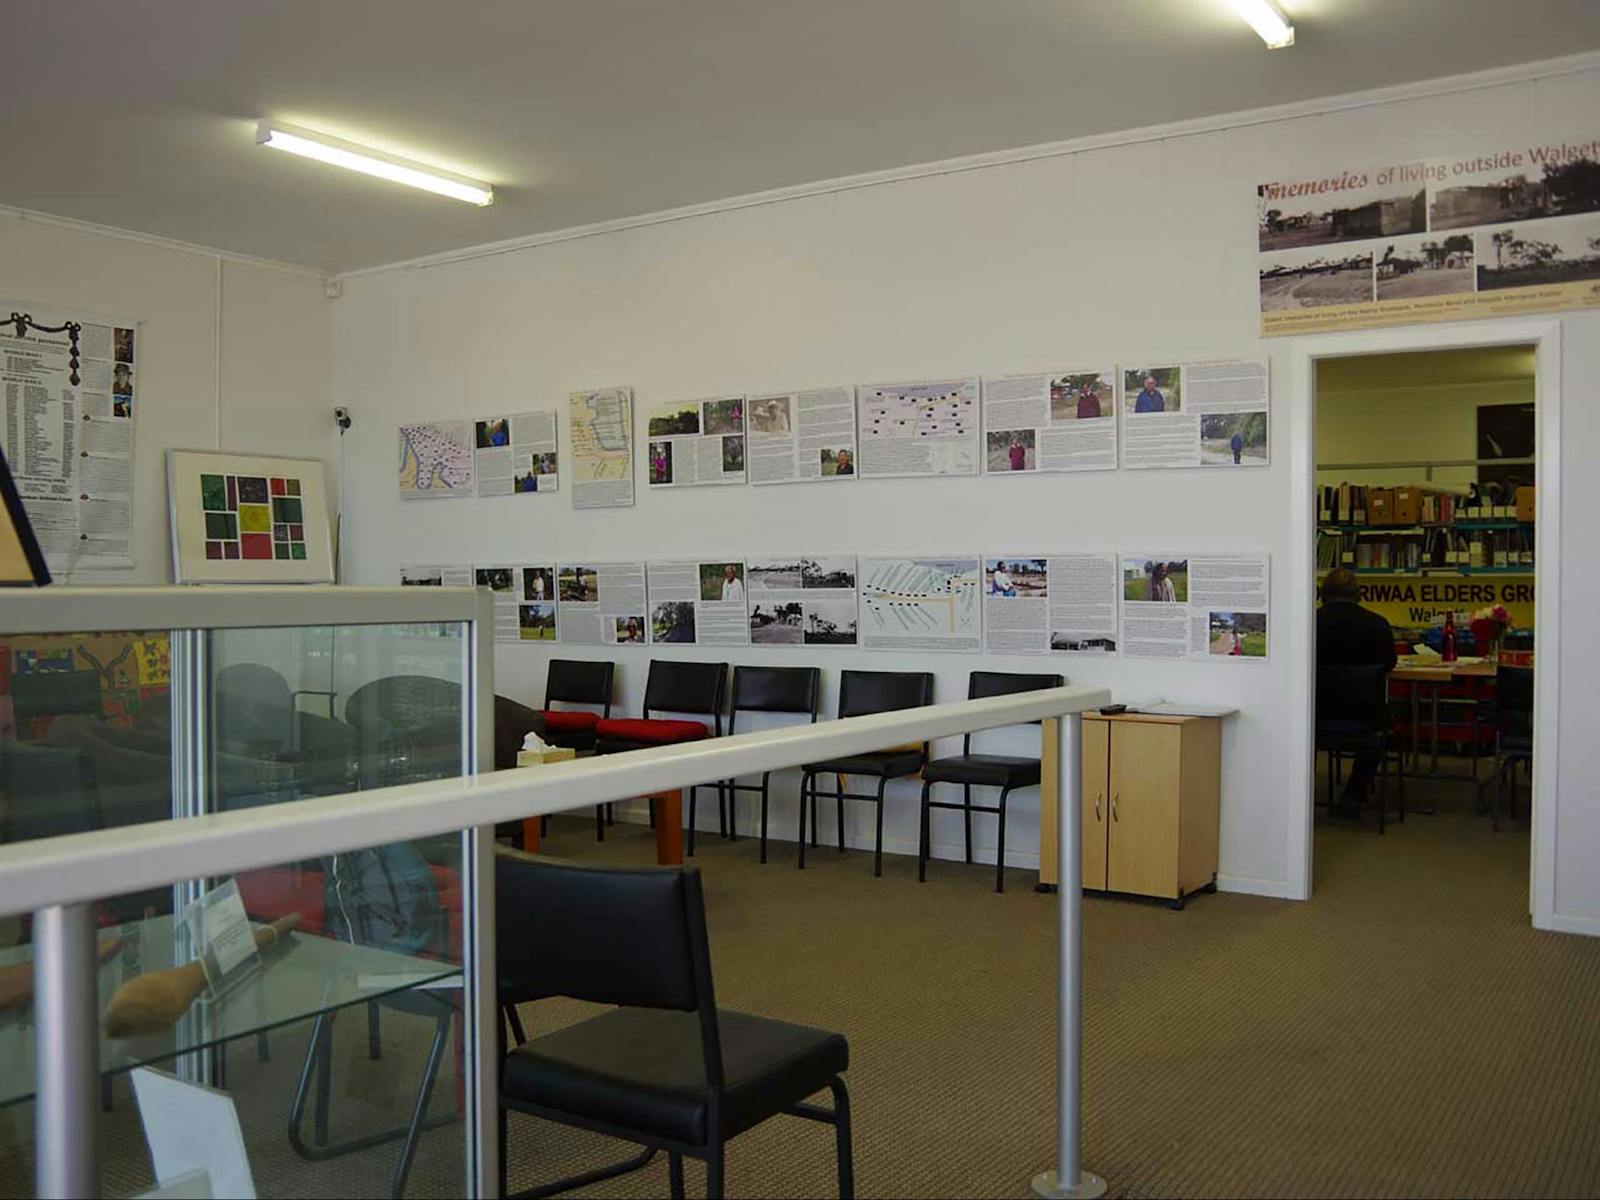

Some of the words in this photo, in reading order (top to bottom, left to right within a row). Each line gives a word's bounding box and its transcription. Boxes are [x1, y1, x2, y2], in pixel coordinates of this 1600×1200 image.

[1377, 167, 1395, 185] of
[1400, 161, 1447, 182] living
[1452, 151, 1523, 175] outside
[1528, 141, 1600, 164] Walget
[1357, 584, 1414, 602] RIWAA
[1420, 584, 1495, 602] ELDERS
